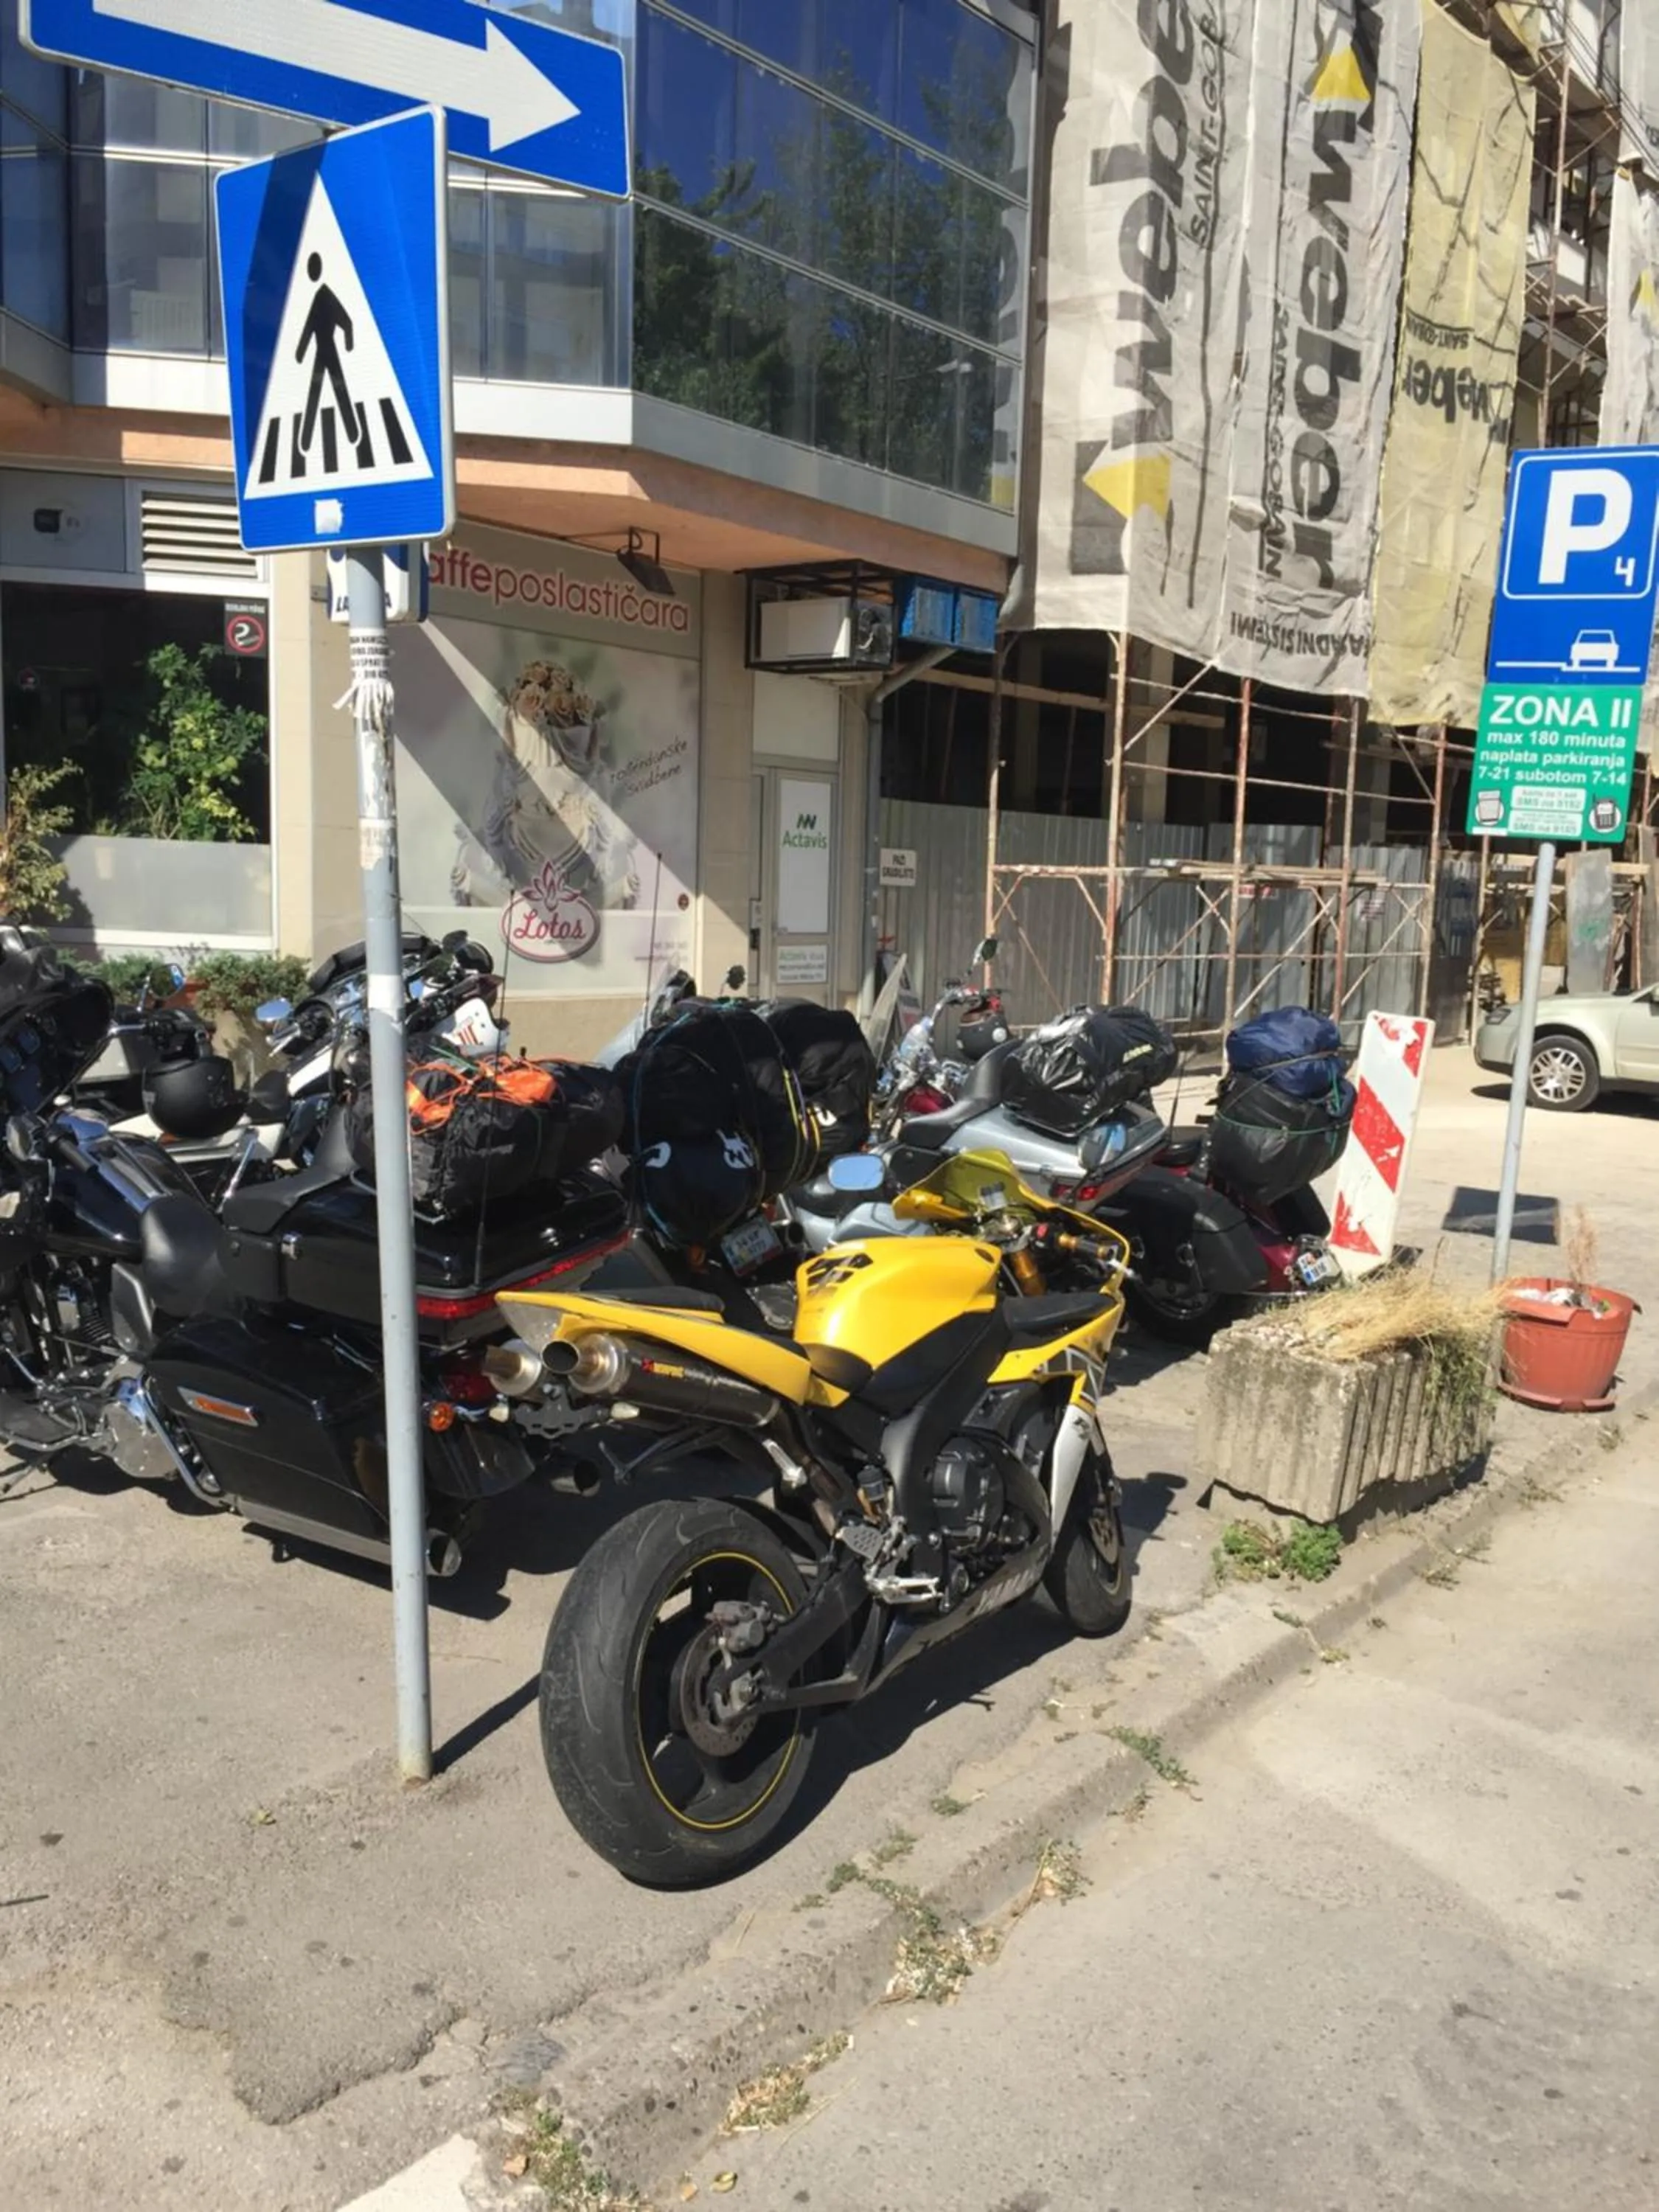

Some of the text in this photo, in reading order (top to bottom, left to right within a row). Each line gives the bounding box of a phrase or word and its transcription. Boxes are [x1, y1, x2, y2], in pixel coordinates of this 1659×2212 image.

[1290, 109, 1360, 588] weber
[1538, 468, 1633, 585] P
[1614, 557, 1635, 587] 4
[1489, 695, 1633, 728] ZONA II
[1487, 730, 1627, 748] max 180 minuta
[1478, 765, 1627, 785] 7-21 subotom 7-14
[1480, 749, 1626, 771] naplata parkiranja
[782, 830, 827, 849] Actavis
[513, 908, 587, 939] Lotos
